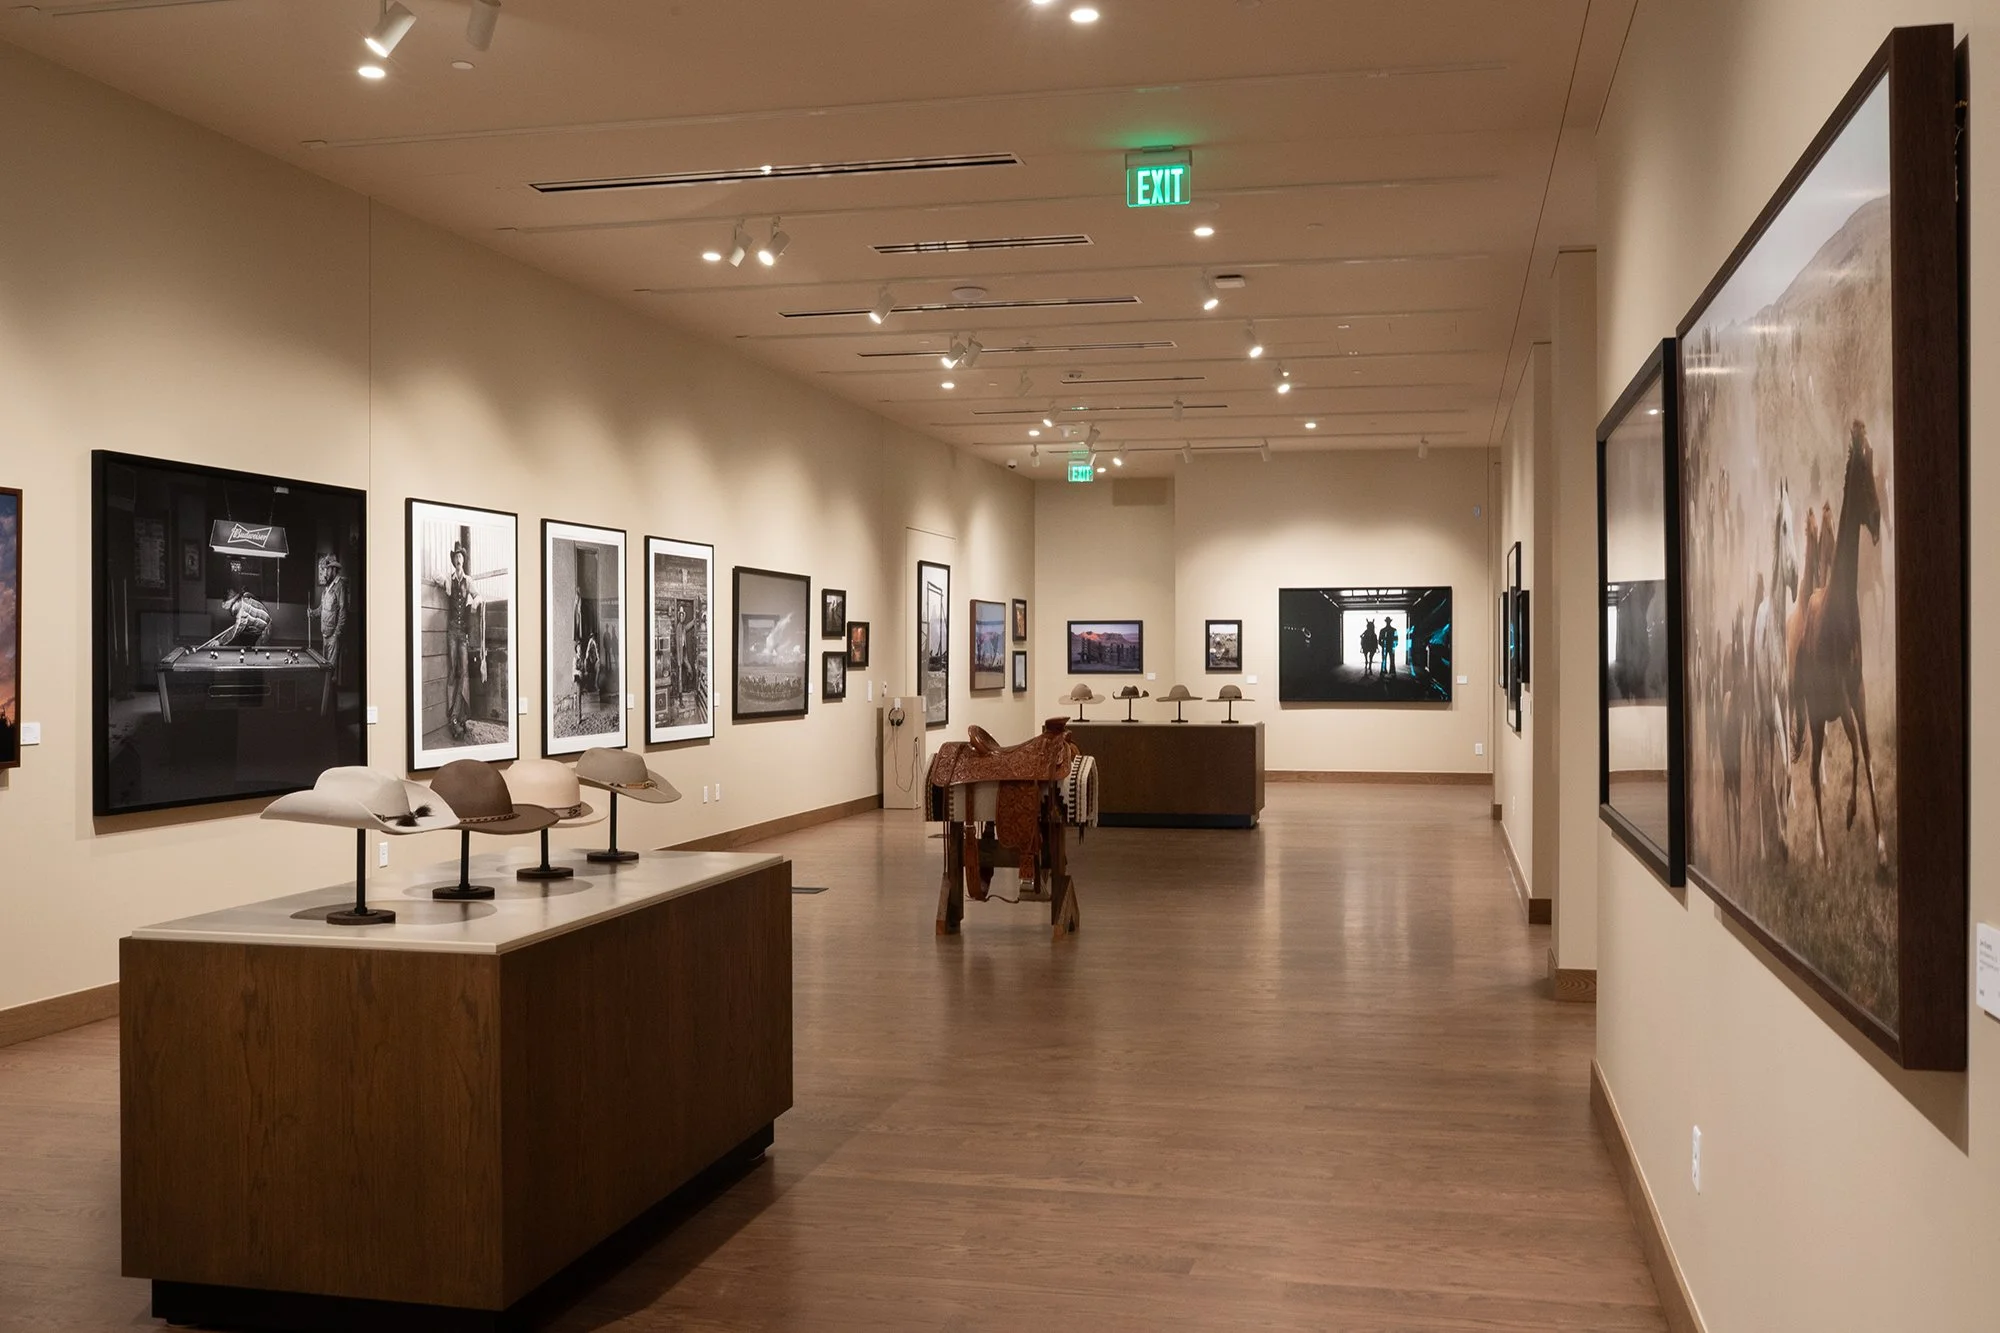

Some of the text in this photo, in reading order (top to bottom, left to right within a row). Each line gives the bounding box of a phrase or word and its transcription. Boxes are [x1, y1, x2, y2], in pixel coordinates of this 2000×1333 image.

[1137, 168, 1184, 205] EXIT
[1072, 466, 1091, 481] EXIT
[231, 527, 268, 541] Budweiser
